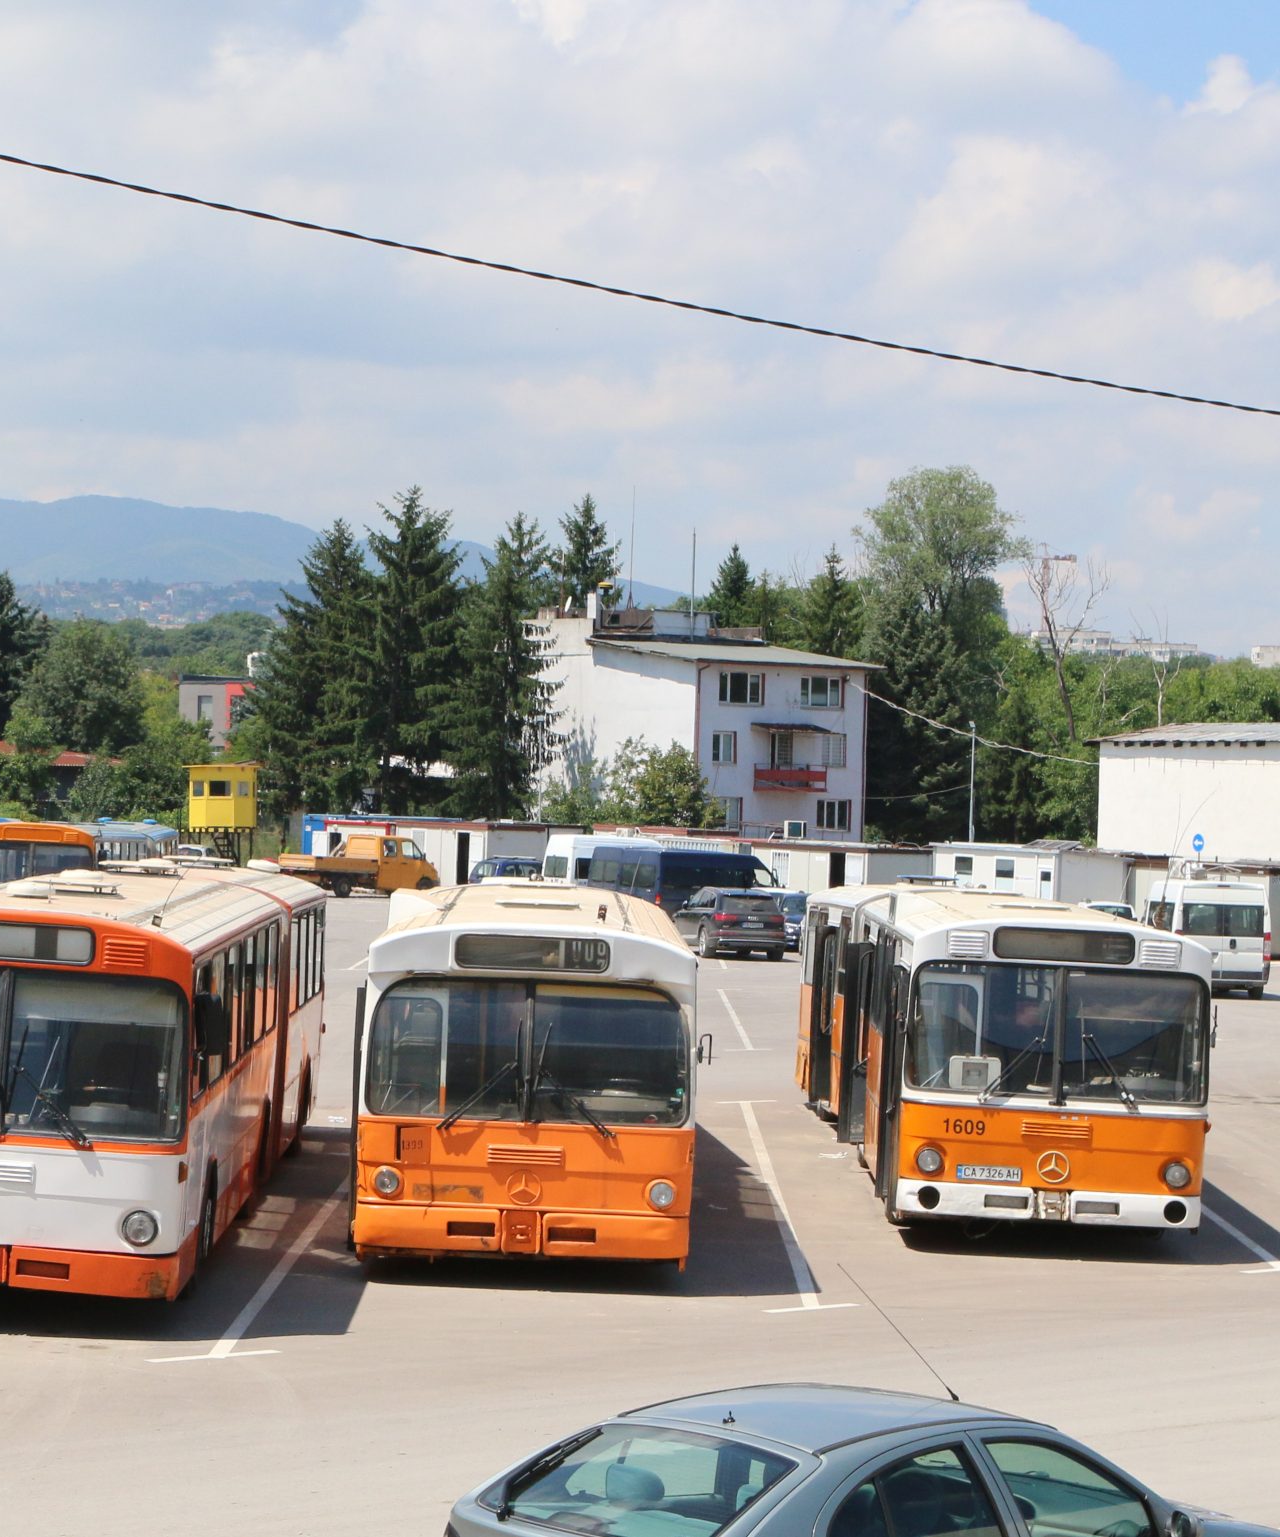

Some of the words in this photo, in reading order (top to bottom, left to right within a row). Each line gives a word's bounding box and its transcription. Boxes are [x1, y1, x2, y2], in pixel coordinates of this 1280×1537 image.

[943, 1118, 986, 1136] 1609
[963, 1166, 977, 1177] CA
[979, 1167, 1004, 1179] 7326
[1006, 1169, 1020, 1180] AH
